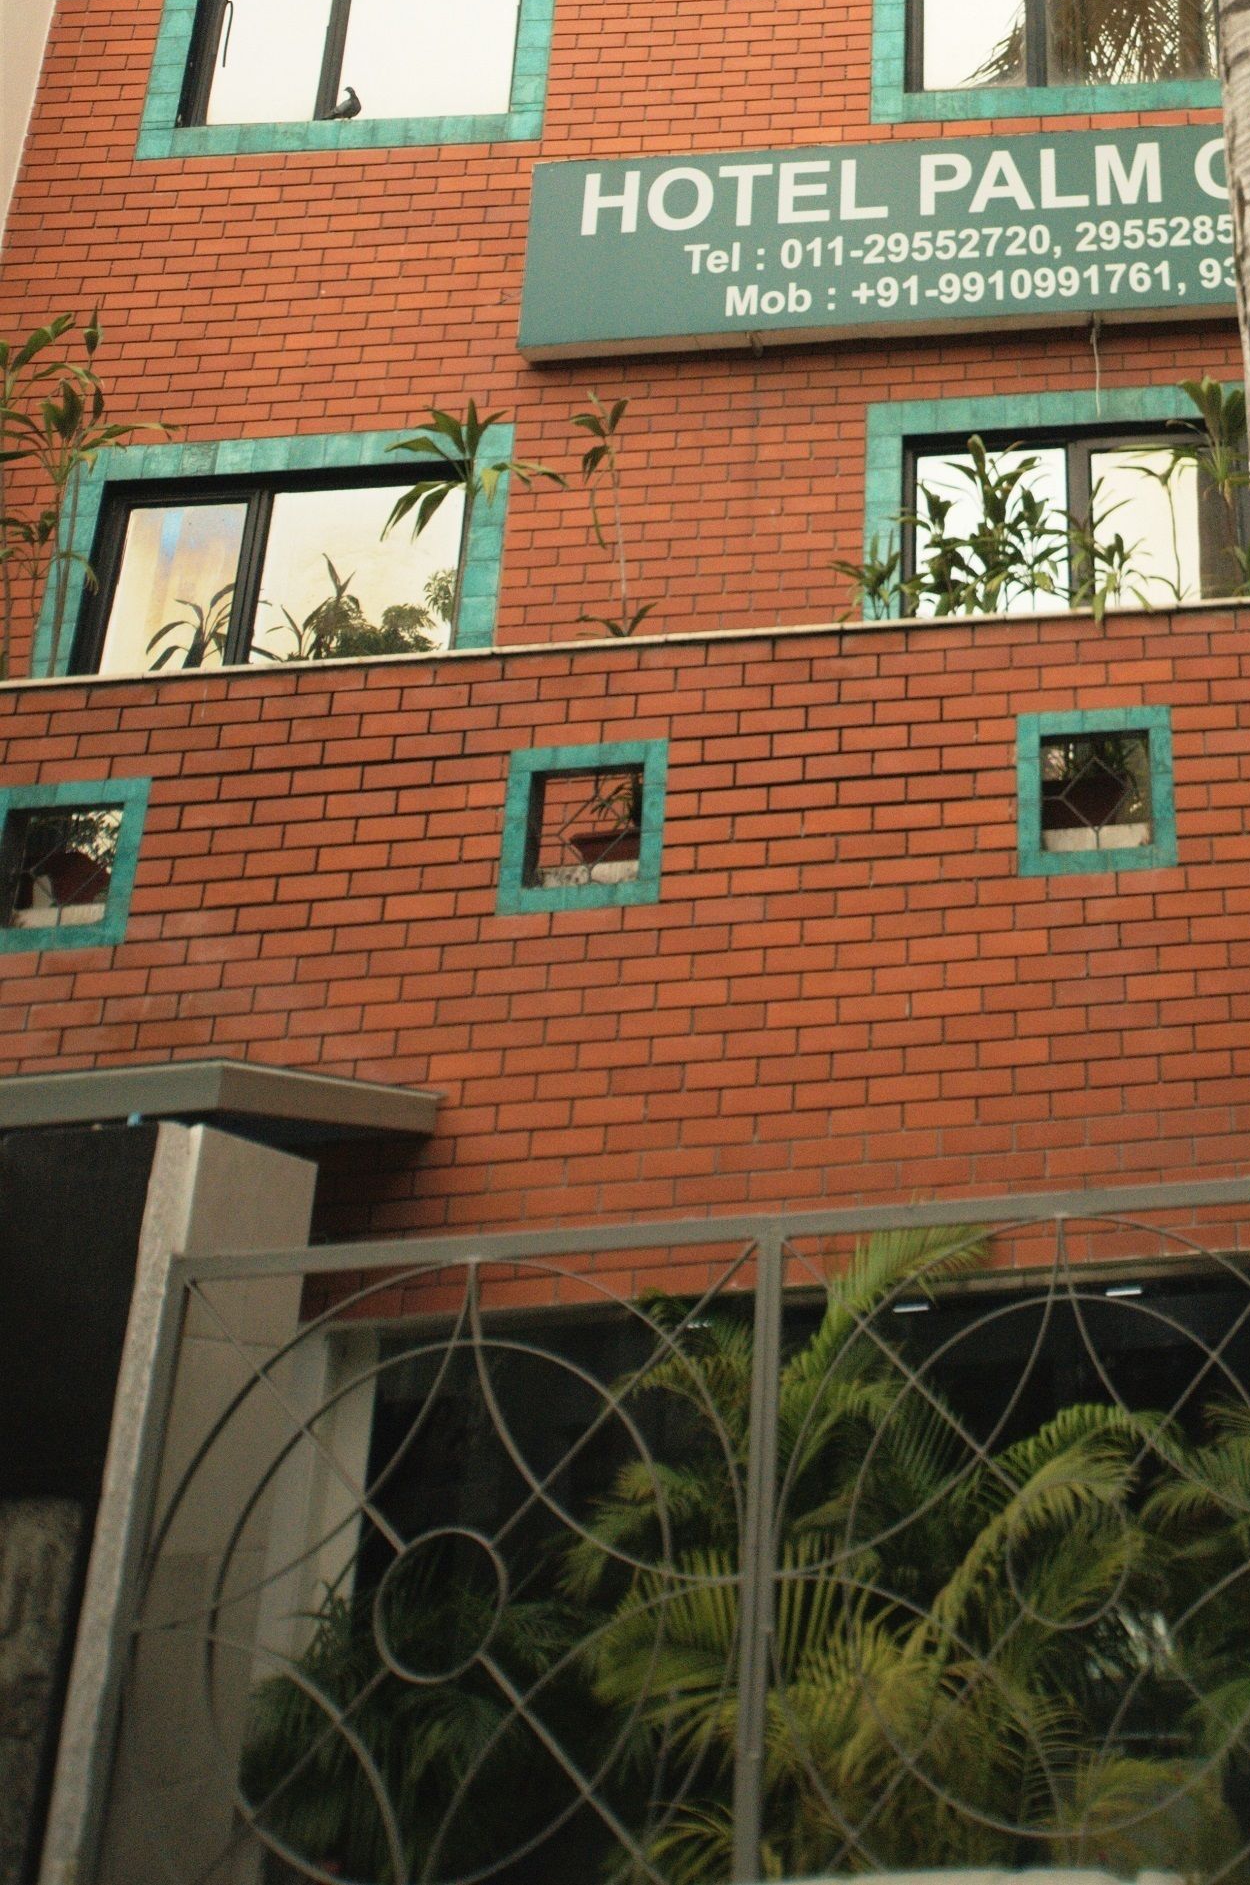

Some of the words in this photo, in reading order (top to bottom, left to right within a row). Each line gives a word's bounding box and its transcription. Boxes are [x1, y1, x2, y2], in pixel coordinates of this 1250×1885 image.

[581, 159, 889, 235] HOTEL
[919, 142, 1161, 215] PALM
[684, 242, 740, 274] Tel
[781, 224, 1061, 269] 011-29552720,
[725, 281, 812, 316] Mob
[852, 261, 1185, 307] +91-9910991761,
